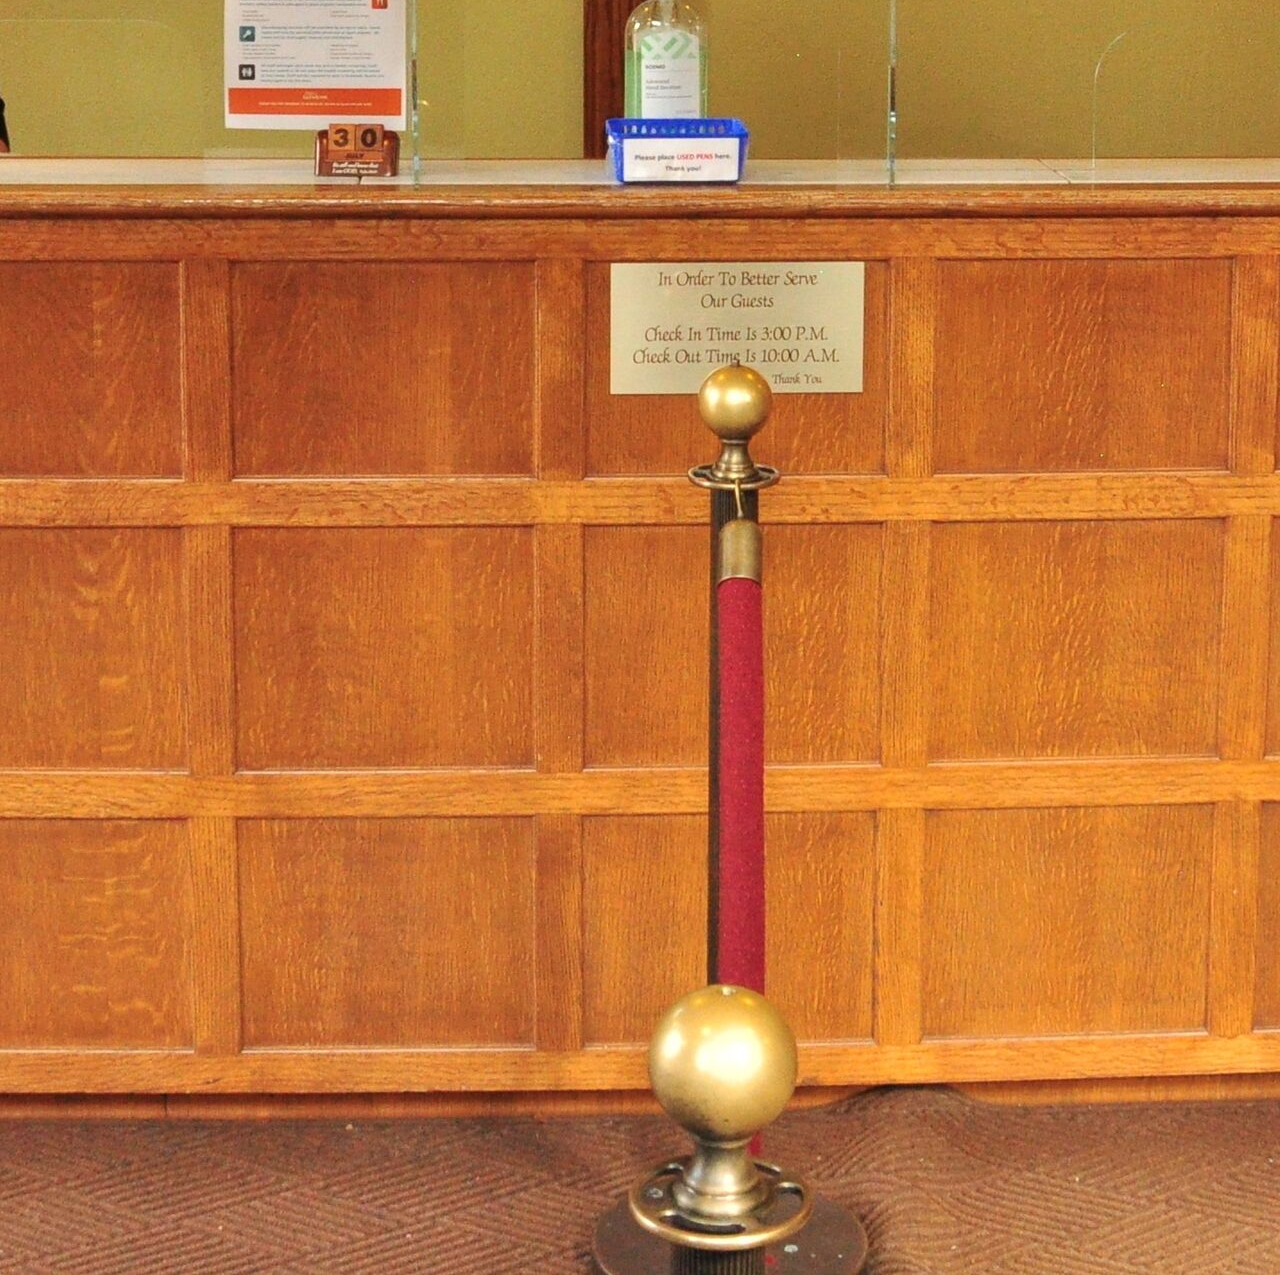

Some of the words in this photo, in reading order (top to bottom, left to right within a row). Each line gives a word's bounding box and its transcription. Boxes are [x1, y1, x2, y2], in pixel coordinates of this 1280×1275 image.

[658, 272, 672, 286] In
[676, 271, 714, 286] Order
[719, 272, 736, 285] To
[741, 271, 780, 286] Better
[783, 271, 817, 286] Serve
[701, 294, 727, 308] Our
[730, 293, 774, 308] Guests
[645, 325, 683, 342] Check
[688, 327, 702, 341] In
[706, 326, 741, 341] Time
[746, 326, 757, 341] Is
[761, 326, 791, 341] 3:00
[795, 326, 828, 341] P.M.
[633, 347, 671, 364] Check
[675, 348, 701, 363] Out
[745, 348, 757, 362] Is
[761, 348, 800, 363] 10:00
[803, 348, 840, 363] A.M.
[772, 373, 801, 384] Thank
[803, 374, 822, 384] You
